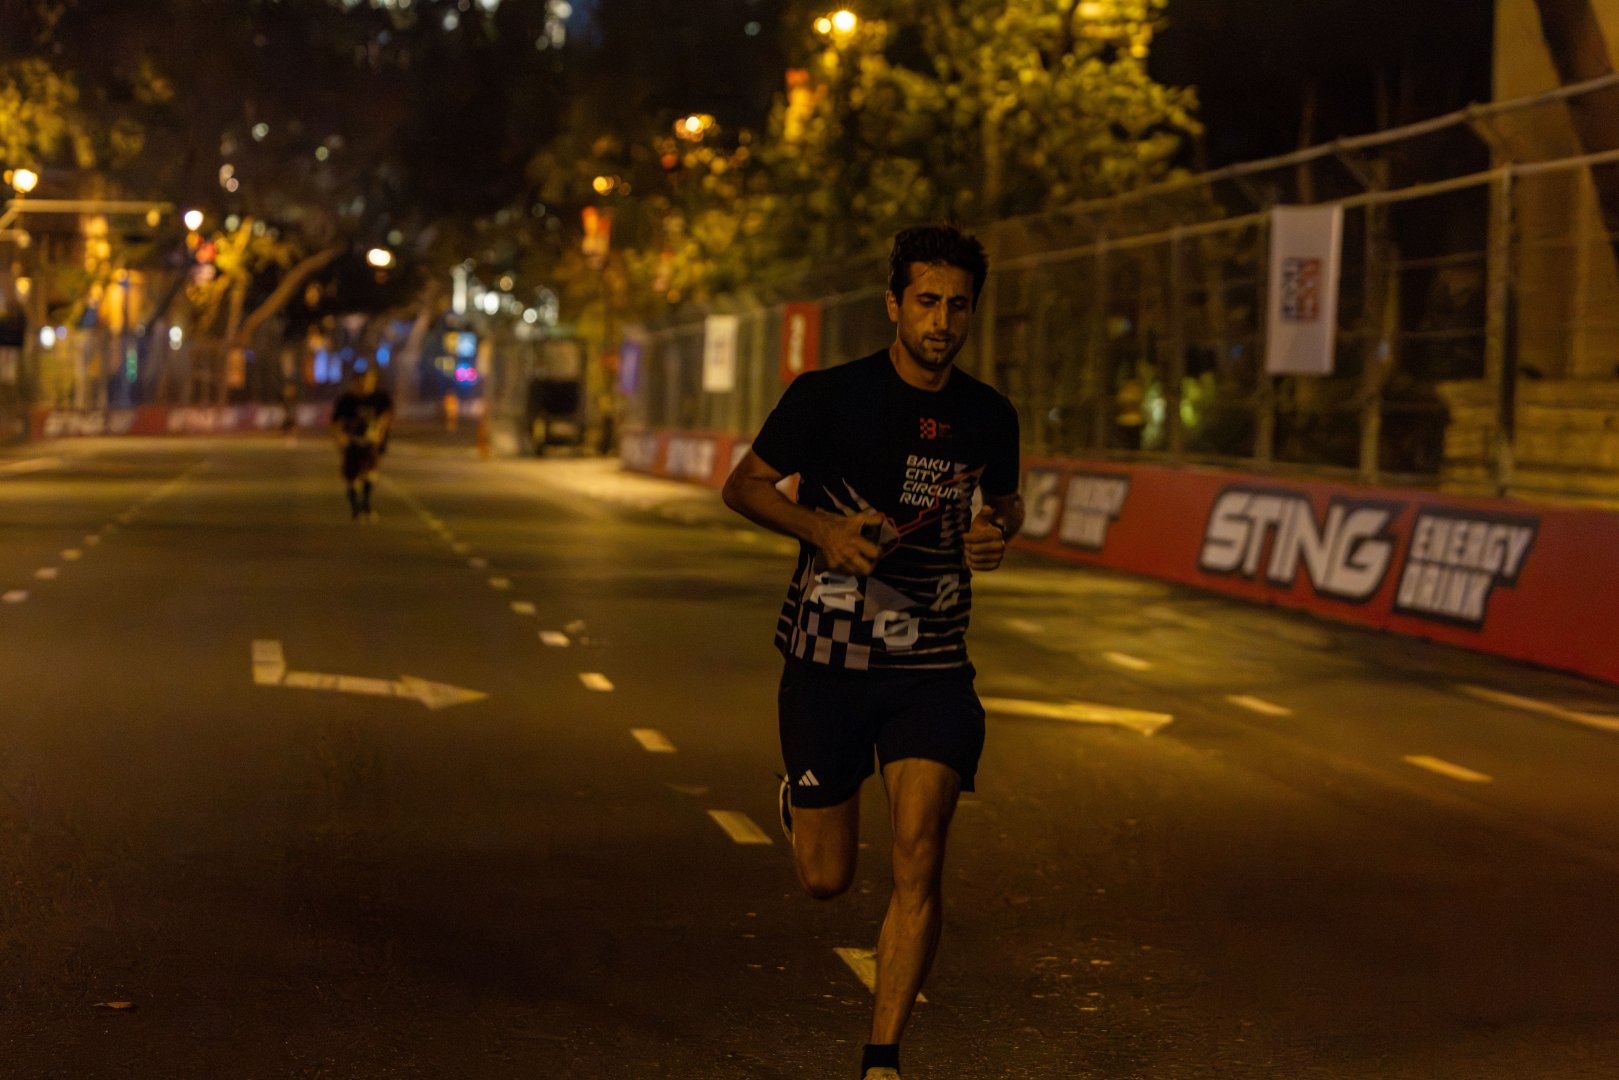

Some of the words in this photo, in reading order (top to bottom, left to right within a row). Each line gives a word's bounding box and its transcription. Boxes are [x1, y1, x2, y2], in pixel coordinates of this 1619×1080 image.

[905, 467, 943, 483] CITY
[906, 454, 951, 473] BAKU
[899, 492, 936, 508] RUN
[1201, 489, 1394, 601] STING
[1410, 514, 1533, 579] ENERGY
[1396, 561, 1493, 624] DRINK
